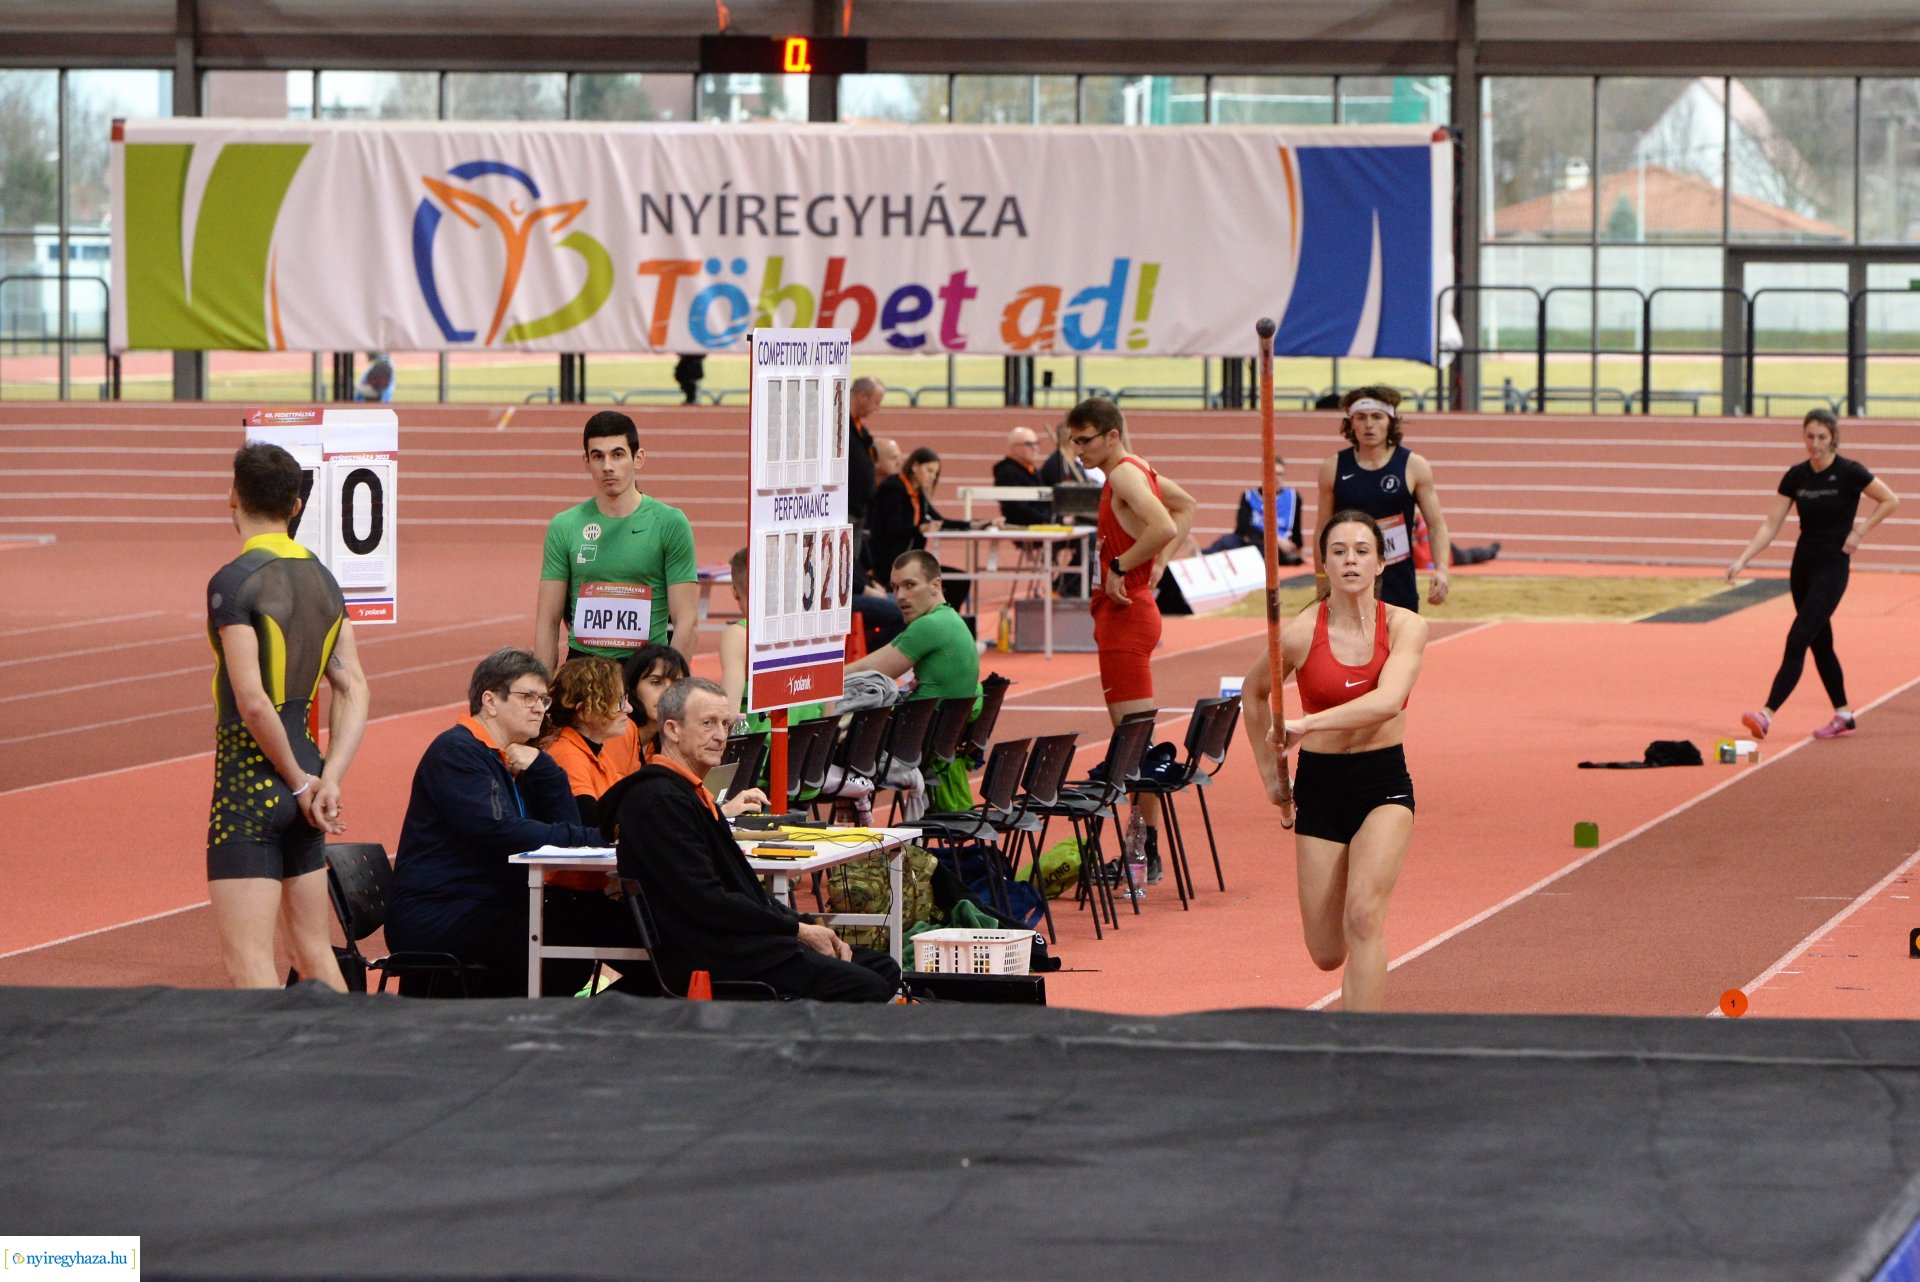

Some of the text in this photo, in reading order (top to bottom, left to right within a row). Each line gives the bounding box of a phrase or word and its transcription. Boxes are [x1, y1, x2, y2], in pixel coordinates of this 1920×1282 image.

[639, 180, 1029, 238] NYÍREGYHÁZA
[637, 255, 1161, 351] Többet ad!
[758, 341, 807, 366] COMPETITOR
[814, 341, 849, 365] ATTEMPT
[774, 493, 829, 521] PERFORMANCE
[583, 609, 641, 631] PAP KR.
[793, 676, 812, 695] polanik
[1044, 861, 1070, 889] ACING
